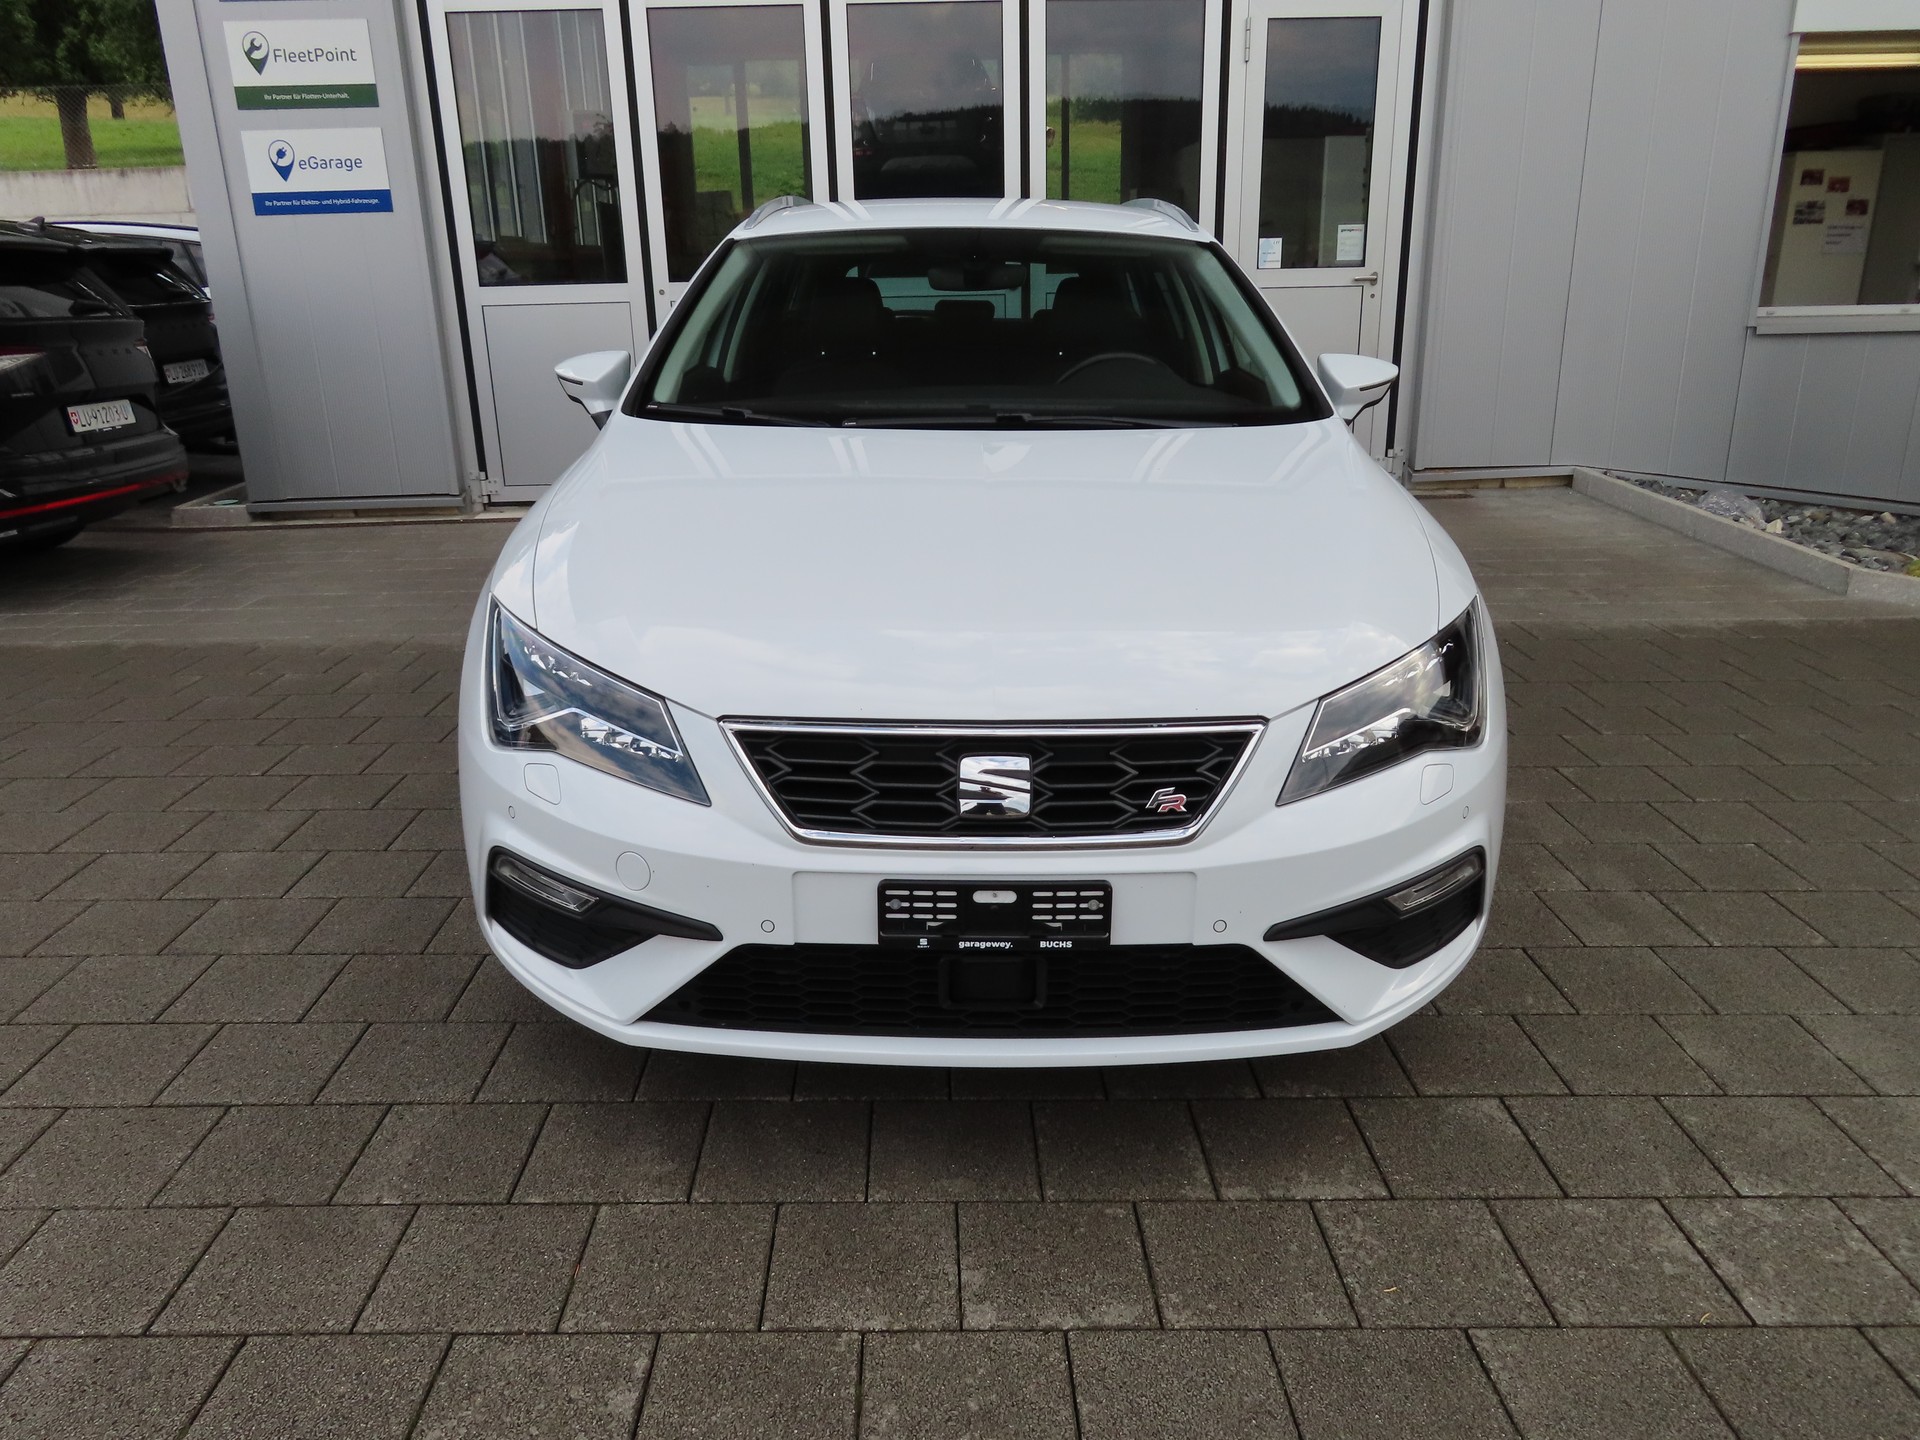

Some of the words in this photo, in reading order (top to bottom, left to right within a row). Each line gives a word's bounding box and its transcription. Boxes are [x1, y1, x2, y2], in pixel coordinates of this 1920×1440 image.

[273, 47, 358, 64] FleetPoint
[298, 155, 363, 172] eGarage
[1145, 786, 1188, 813] FR
[958, 940, 1014, 949] garagewey.
[1039, 940, 1073, 948] BUCHS
